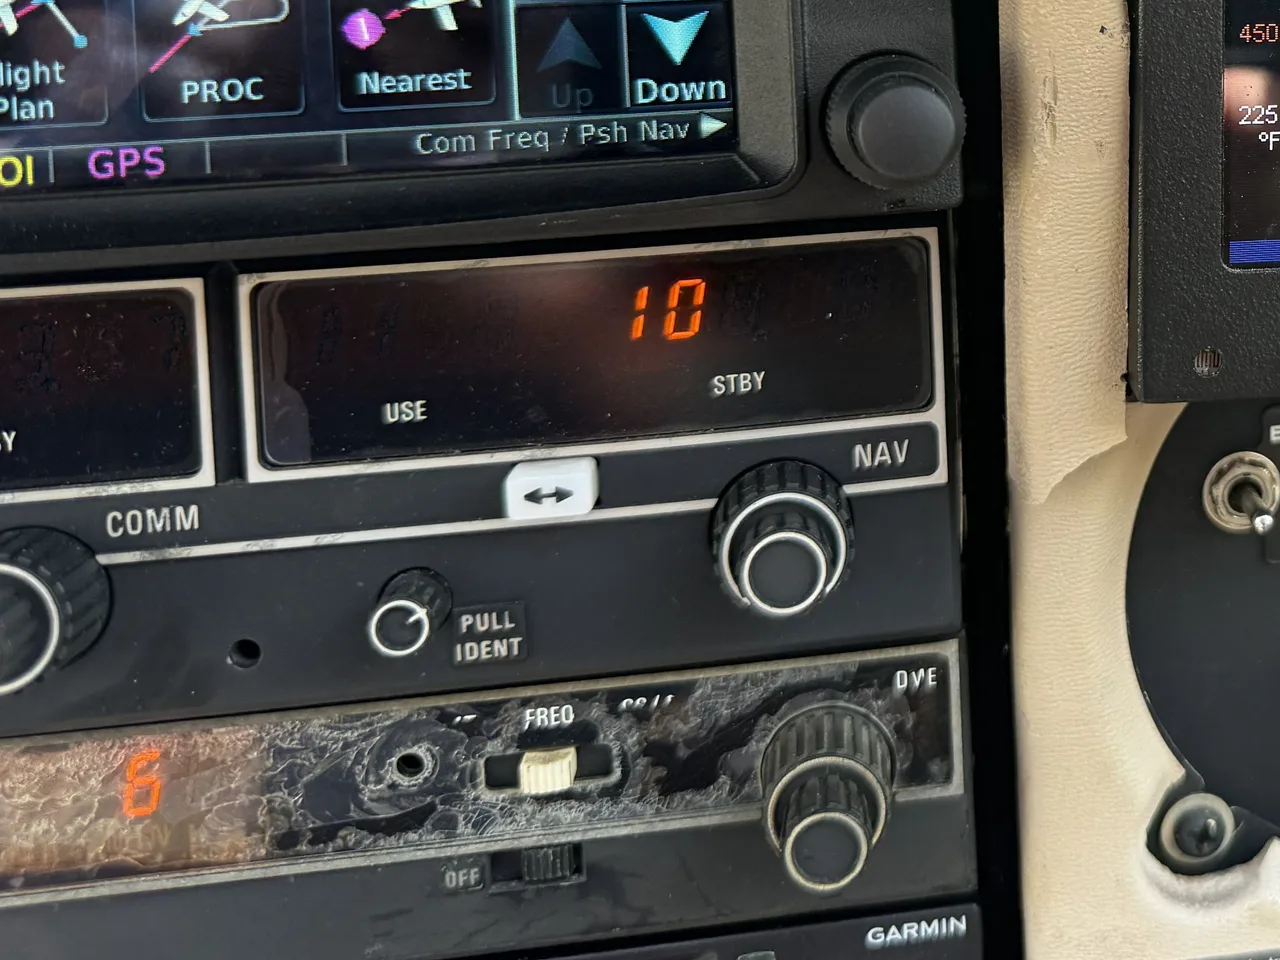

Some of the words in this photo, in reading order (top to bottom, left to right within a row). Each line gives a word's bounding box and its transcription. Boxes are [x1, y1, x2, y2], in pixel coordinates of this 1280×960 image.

[1239, 23, 1280, 43] 450
[181, 78, 266, 104] PROC
[358, 69, 473, 95] Nearest
[636, 77, 728, 104] Down
[551, 83, 594, 112] Up
[1238, 105, 1279, 125] 225
[415, 133, 477, 155] Com
[488, 128, 550, 152] Freq
[580, 121, 629, 145] Psh
[640, 120, 690, 141] Nav
[88, 146, 166, 180] GPS
[630, 278, 706, 340] 10
[712, 370, 766, 396] STBY
[384, 400, 428, 424] USE
[852, 439, 911, 470] NAV
[106, 504, 201, 538] COMM
[460, 611, 516, 634] PULL
[455, 637, 523, 663] IDENT
[123, 749, 162, 817] 6
[444, 868, 481, 889] OFF
[866, 915, 968, 945] GARMIN
